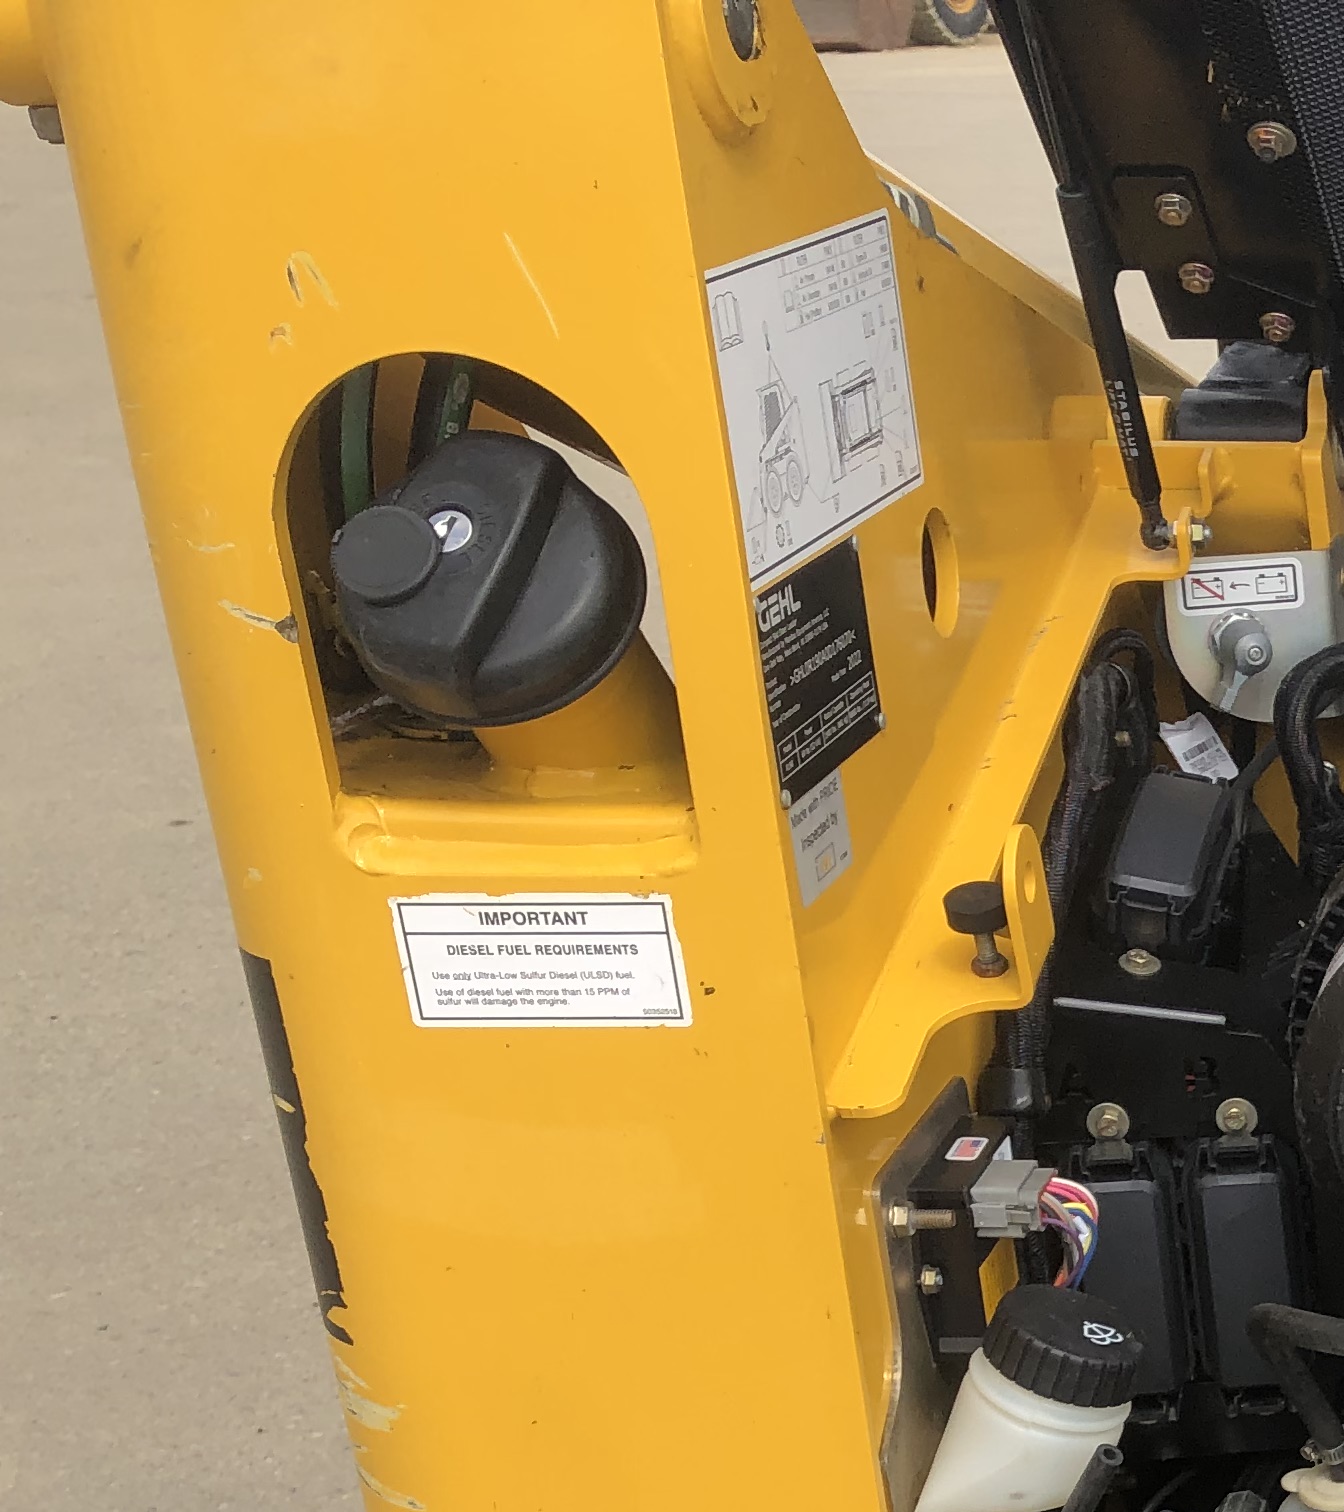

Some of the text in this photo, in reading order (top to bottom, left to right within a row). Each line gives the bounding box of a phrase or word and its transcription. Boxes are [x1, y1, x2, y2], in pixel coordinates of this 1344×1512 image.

[1114, 381, 1139, 457] STABILUS
[754, 584, 802, 632] GEHL
[478, 911, 588, 926] IMPORTANT
[446, 944, 638, 956] DIESEL FUEL REQUIREMENTS
[431, 970, 635, 981] Use only Ultra-Low Sulfur Diesel (ULSD) fuel.
[435, 988, 453, 996] Use
[456, 988, 465, 996] of
[467, 988, 494, 996] diesel
[496, 988, 513, 996] fuel
[515, 988, 534, 996] with
[561, 988, 582, 996] than
[585, 988, 595, 996] 15
[598, 988, 619, 996] PPM
[621, 988, 630, 996] of
[437, 997, 462, 1005] sulfur
[481, 998, 518, 1007] damage
[537, 997, 570, 1007] engine.
